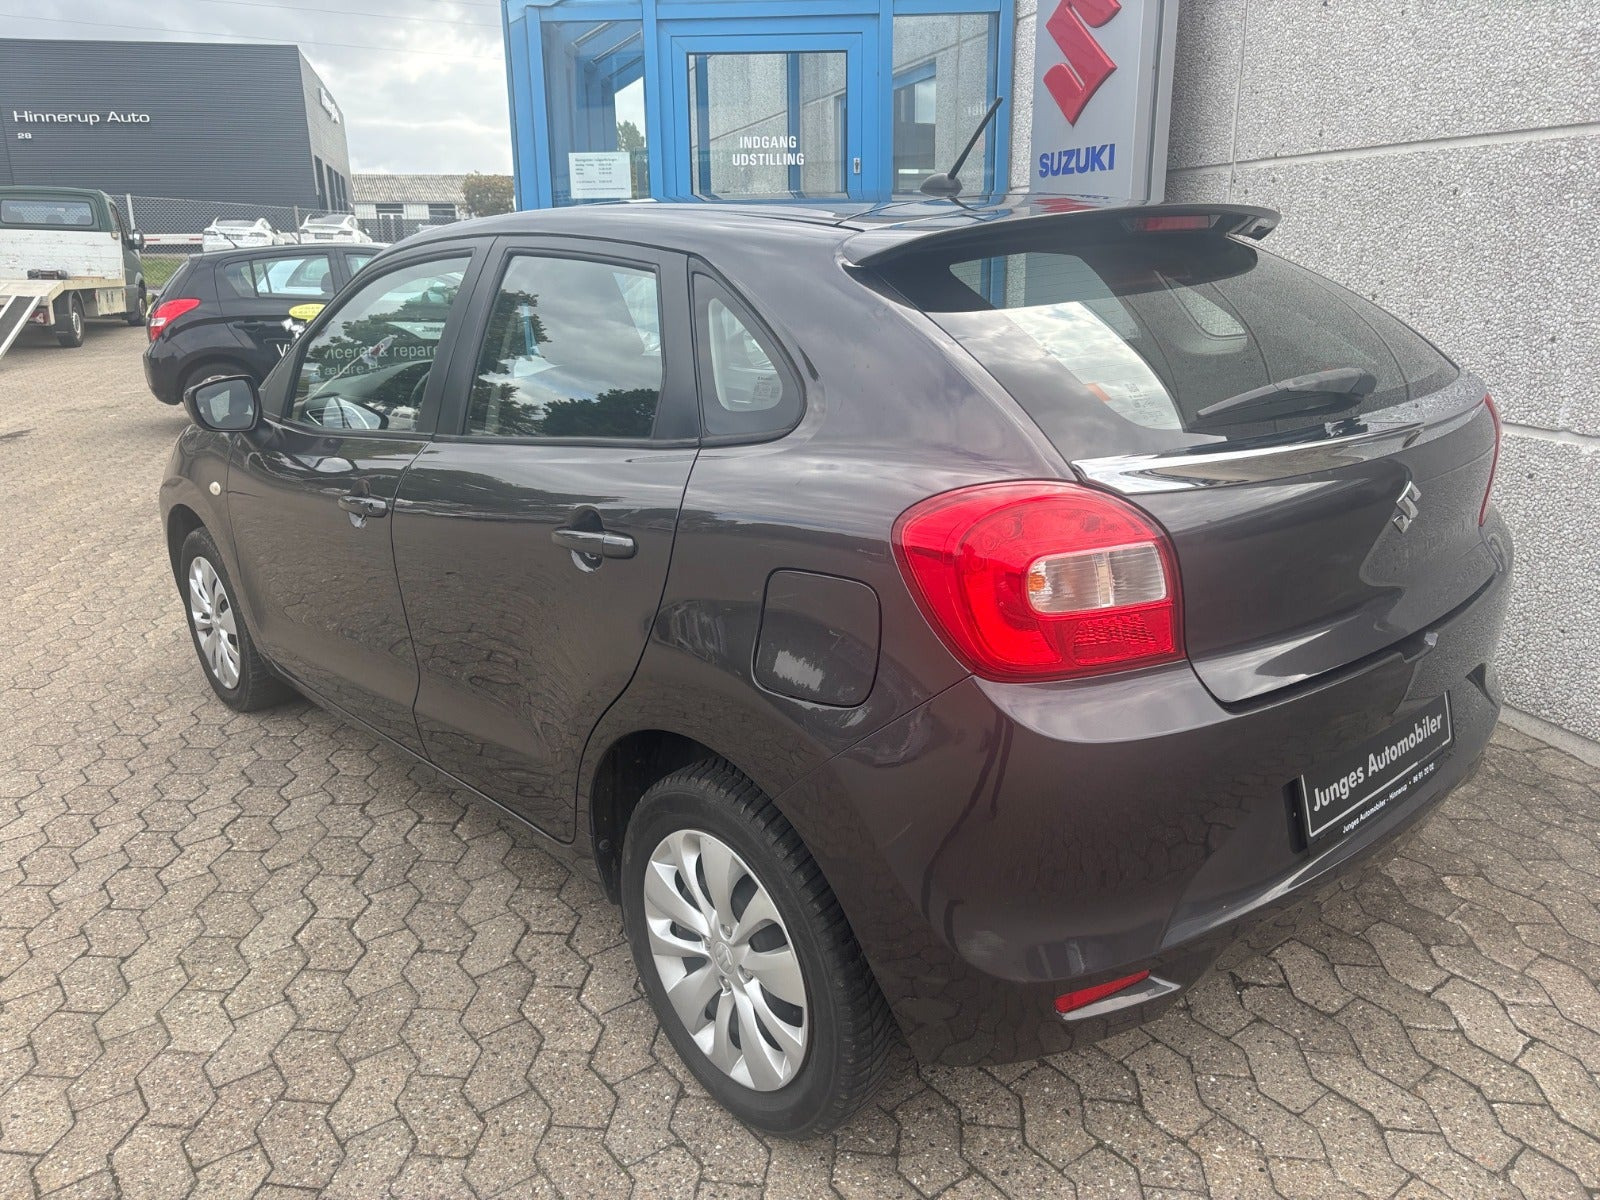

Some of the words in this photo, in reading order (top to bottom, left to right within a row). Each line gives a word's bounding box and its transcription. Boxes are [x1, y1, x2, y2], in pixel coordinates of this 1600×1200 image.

[13, 110, 100, 125] Hinnerup
[107, 110, 150, 123] Auto
[740, 136, 797, 149] INDGANG
[732, 153, 805, 166] UDSTILLING
[1038, 143, 1115, 178] SUZUKI
[1313, 766, 1365, 812] Junges
[1368, 713, 1443, 777] Automobiler
